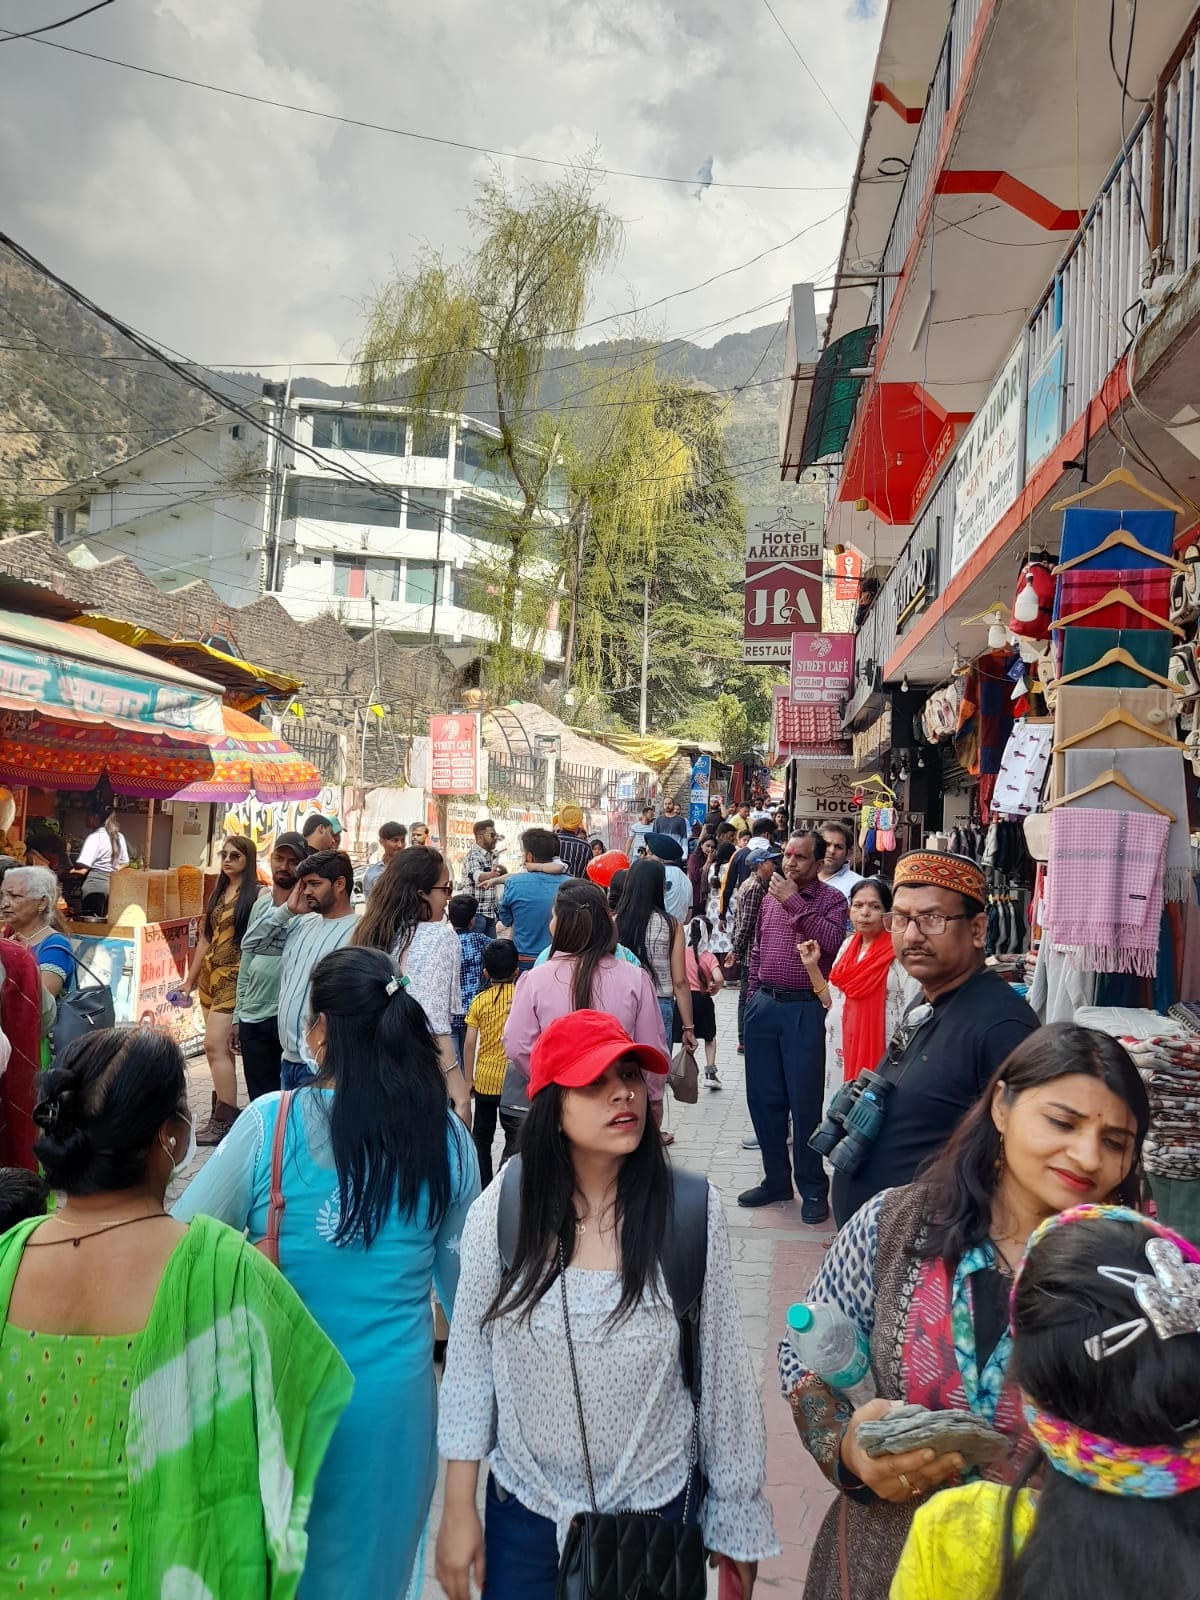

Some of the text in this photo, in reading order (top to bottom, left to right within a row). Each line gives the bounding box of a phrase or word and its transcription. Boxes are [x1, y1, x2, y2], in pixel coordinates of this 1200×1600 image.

[975, 494, 986, 521] Day
[988, 459, 1015, 504] Delivery
[762, 531, 807, 545] Hotel
[749, 545, 819, 558] AAKARSH
[797, 658, 848, 672] STREET CAFÉ
[817, 798, 861, 812] Hote
[141, 959, 165, 983] Bhel
